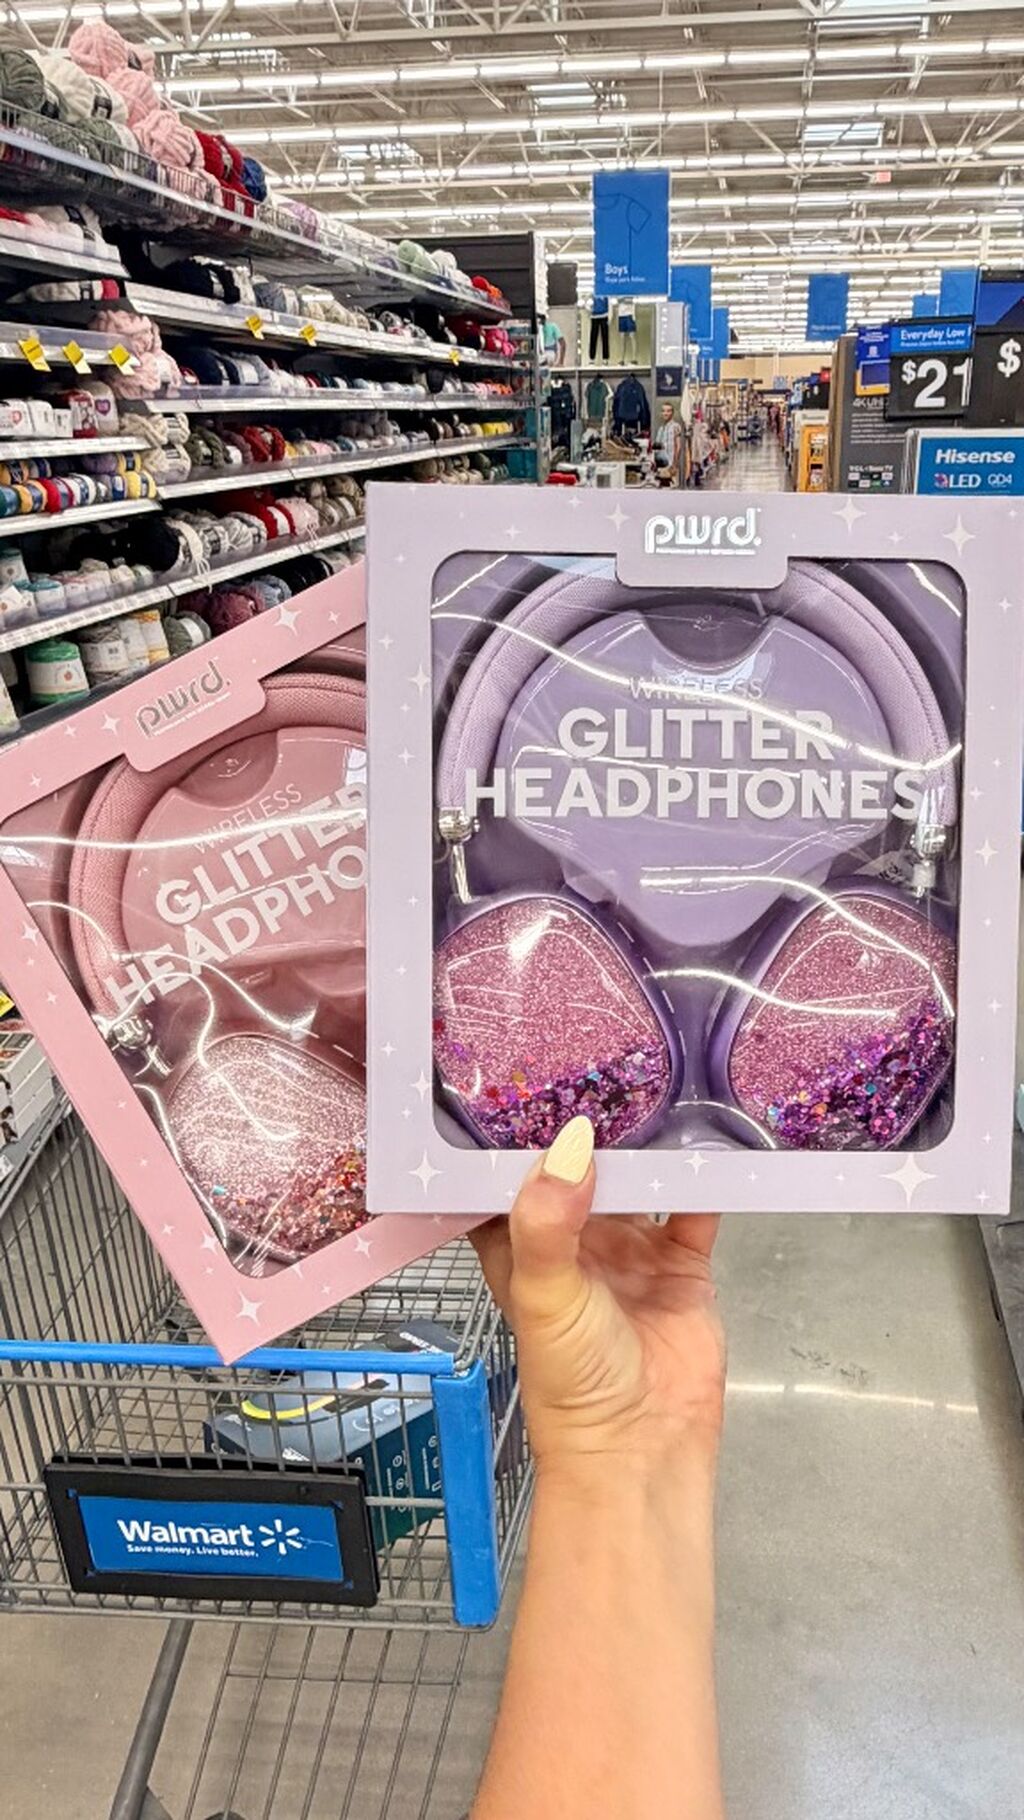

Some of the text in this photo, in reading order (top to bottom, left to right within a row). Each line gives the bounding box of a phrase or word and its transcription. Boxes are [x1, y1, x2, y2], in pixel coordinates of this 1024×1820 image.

[605, 263, 628, 277] Boys
[900, 328, 944, 341] Everyday
[946, 327, 966, 338] Low
[935, 448, 1016, 464] Hisense
[558, 707, 835, 760] GLITTER
[465, 765, 925, 820] HEADPHONES
[117, 1519, 255, 1547] Walmart
[127, 1544, 259, 1558] Save money. Live better.
